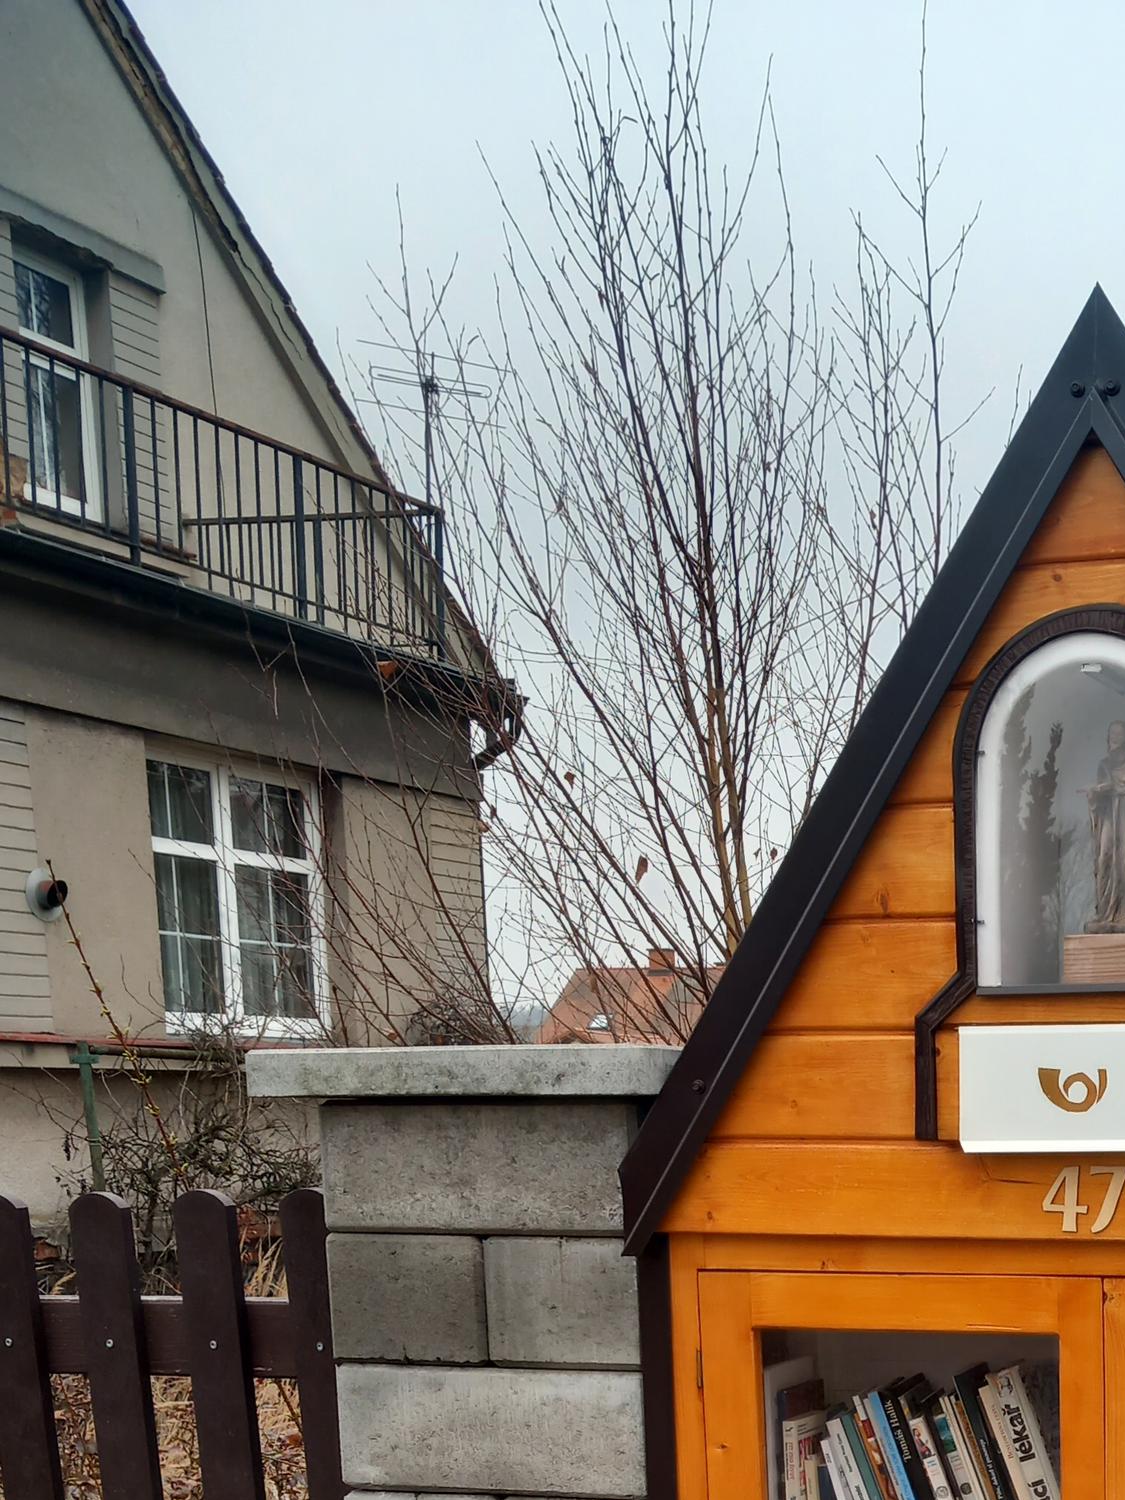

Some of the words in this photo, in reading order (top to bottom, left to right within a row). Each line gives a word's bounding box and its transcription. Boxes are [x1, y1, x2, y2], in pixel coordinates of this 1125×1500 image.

[884, 1399, 900, 1431] Halík
[895, 1429, 912, 1463] Tomáš
[1002, 1404, 1036, 1463] lékař
